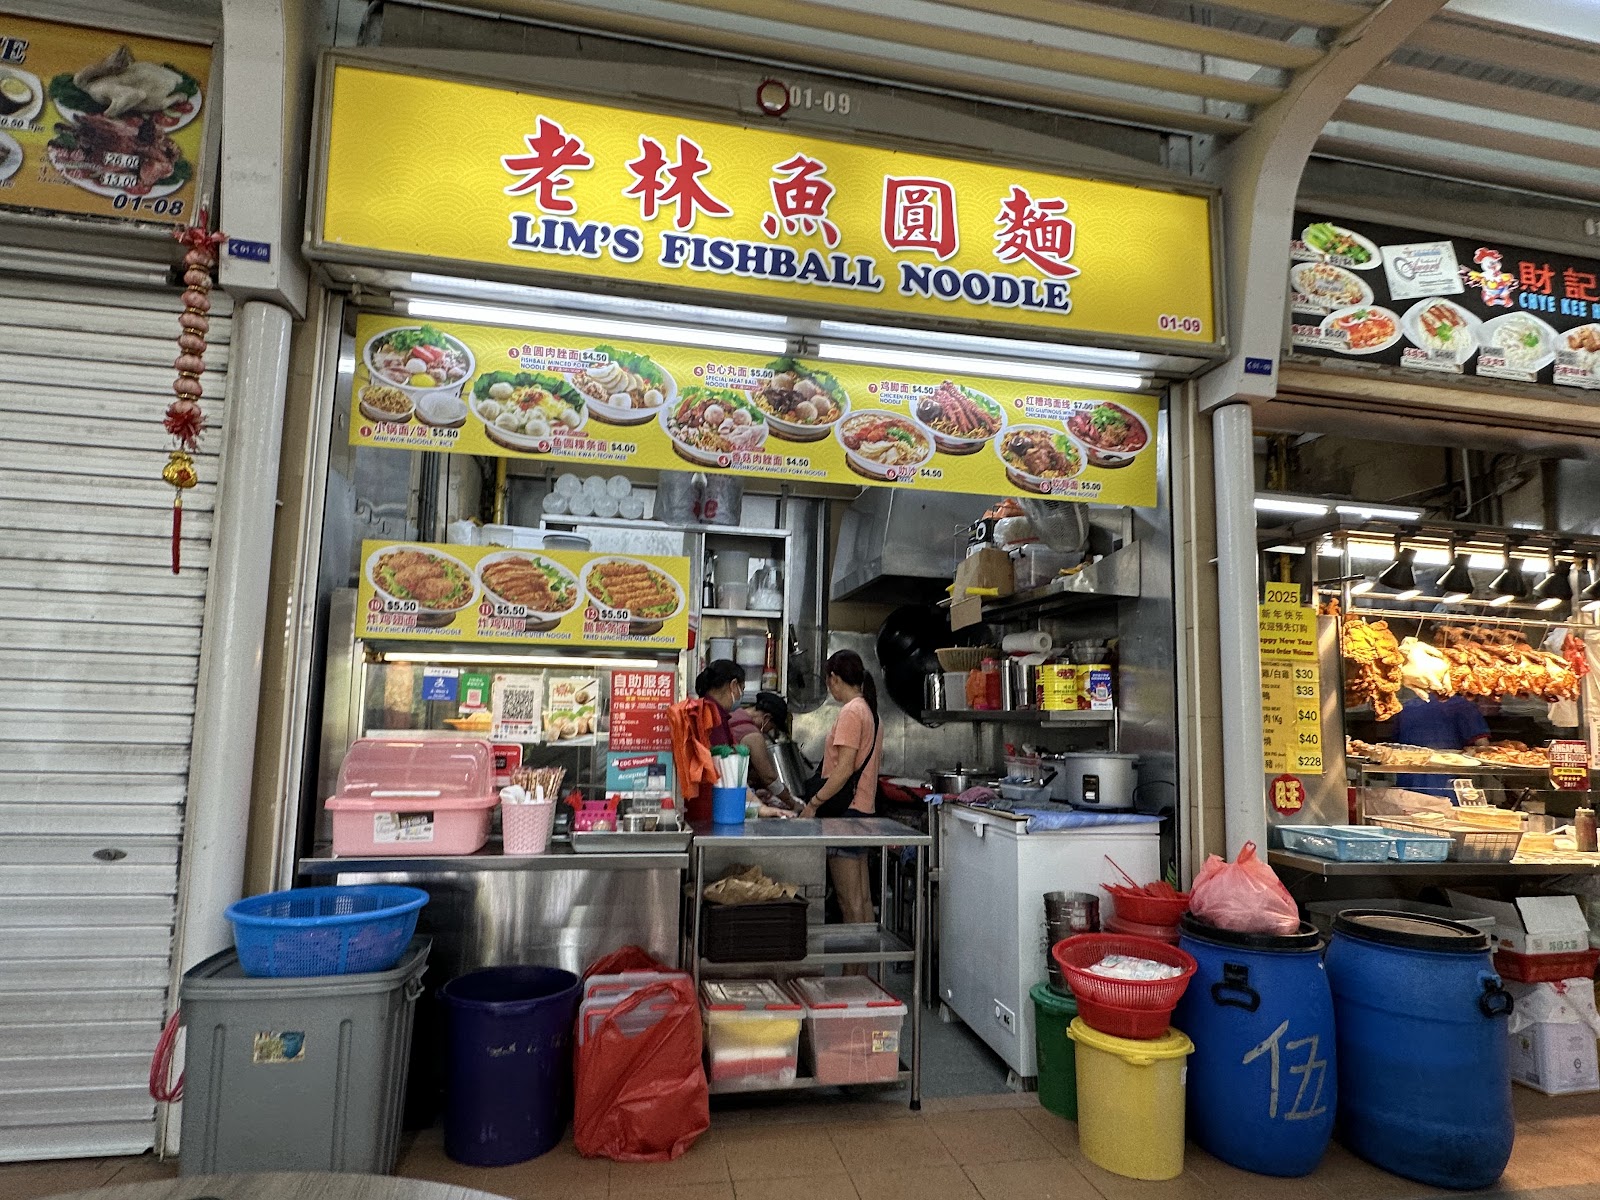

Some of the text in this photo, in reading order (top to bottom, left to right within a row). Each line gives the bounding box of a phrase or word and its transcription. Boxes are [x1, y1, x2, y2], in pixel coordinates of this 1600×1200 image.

[789, 86, 850, 114] 01-09
[503, 117, 1079, 277] 老林魚圓麵
[113, 195, 184, 216] 01-08
[512, 215, 1071, 311] LIM'S FISHBALL NOODLE
[1518, 261, 1600, 302] 財記
[1561, 298, 1587, 317] KEE
[1160, 316, 1200, 333] 01-09
[582, 352, 607, 362] $4.50
[706, 364, 747, 377] 包心丸面
[750, 369, 773, 378] $5.00
[881, 382, 909, 393] 鸡脚面
[912, 385, 933, 394] $4.50
[432, 429, 458, 438] $5.80
[551, 448, 577, 457] FISHBALL
[611, 443, 635, 453] $4.00
[787, 457, 809, 467] $4.50
[731, 464, 764, 472] MUSHROOM
[921, 469, 942, 478] $4.50
[1081, 482, 1101, 490] $5.00
[1268, 590, 1297, 603] 2025
[369, 599, 381, 610] 10
[387, 601, 416, 611] $5.50
[480, 604, 492, 615] 11
[497, 606, 525, 615] $5.50
[585, 609, 596, 619] 12
[601, 610, 628, 619] $5.50
[1262, 609, 1303, 620] 新年快乐
[1296, 669, 1313, 679] $30
[615, 674, 671, 688] 自助服务
[615, 688, 671, 696] SELF-SERVICE
[1296, 685, 1314, 696] $38
[1298, 709, 1317, 721] $40
[1299, 733, 1318, 744] $40
[620, 759, 631, 767] CDC
[1298, 756, 1321, 766] $228
[618, 770, 647, 780] Accepted
[1275, 781, 1301, 808] 旺
